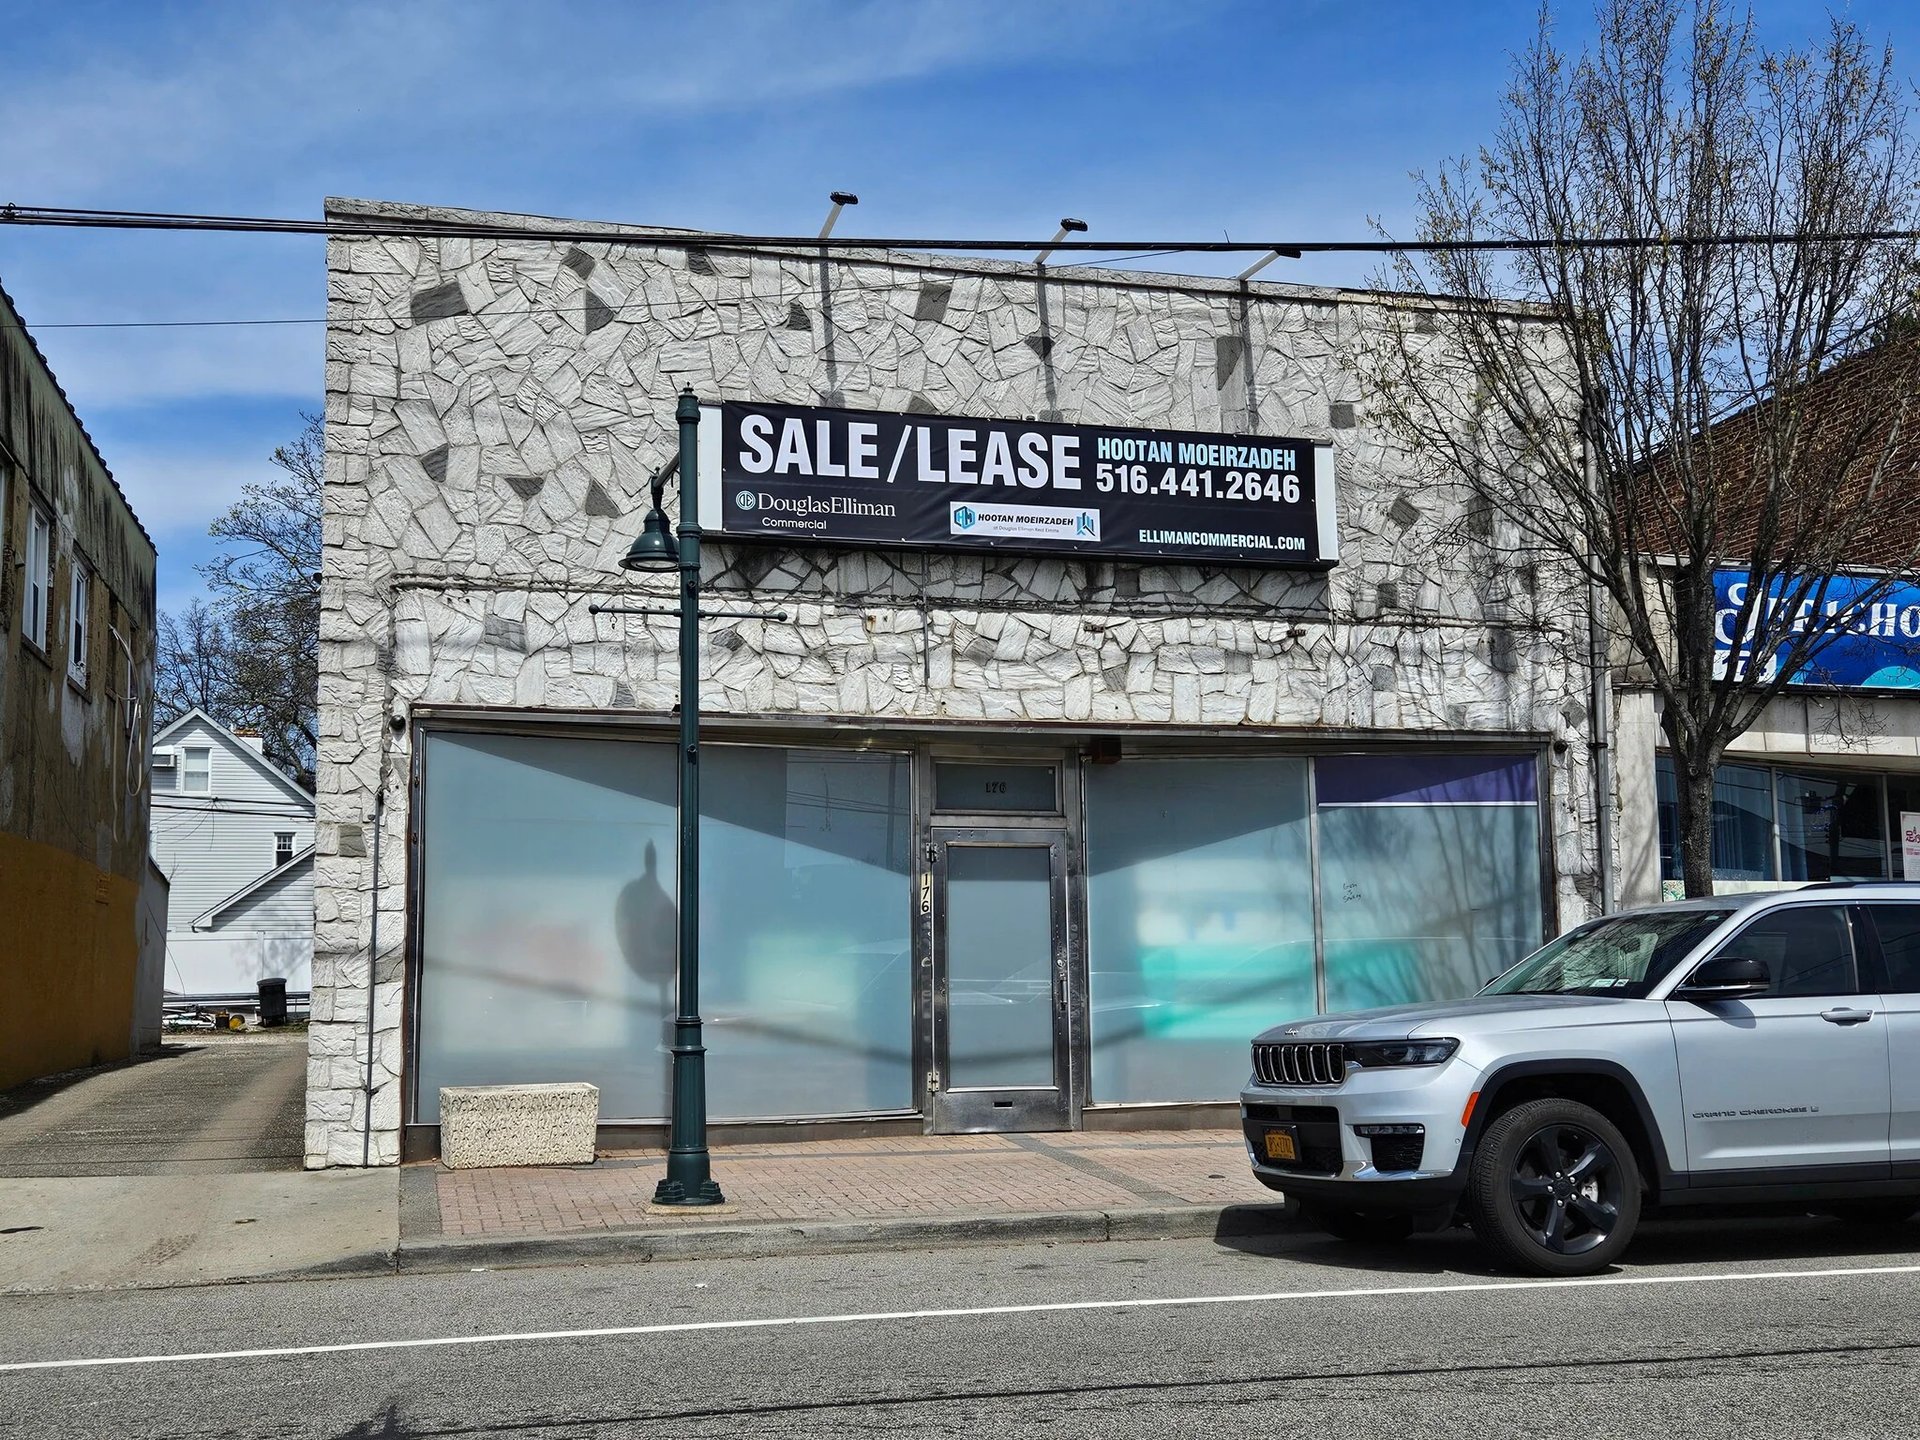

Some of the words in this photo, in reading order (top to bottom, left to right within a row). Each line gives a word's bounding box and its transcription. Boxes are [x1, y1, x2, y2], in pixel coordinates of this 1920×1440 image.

[1098, 438, 1173, 463] HOOTAN
[1178, 443, 1296, 471] MOEIRZADEH
[1096, 463, 1300, 503] 516.441.2646
[762, 517, 826, 529] Commercial
[978, 514, 1014, 523] HOOTAN
[1016, 516, 1074, 526] MOEIRZADEH
[1139, 529, 1306, 550] ELLIMANCOMMERCIAL.COM
[985, 782, 1006, 793] 176
[922, 873, 930, 912] 176
[1739, 1107, 1807, 1116] CHEROKEE
